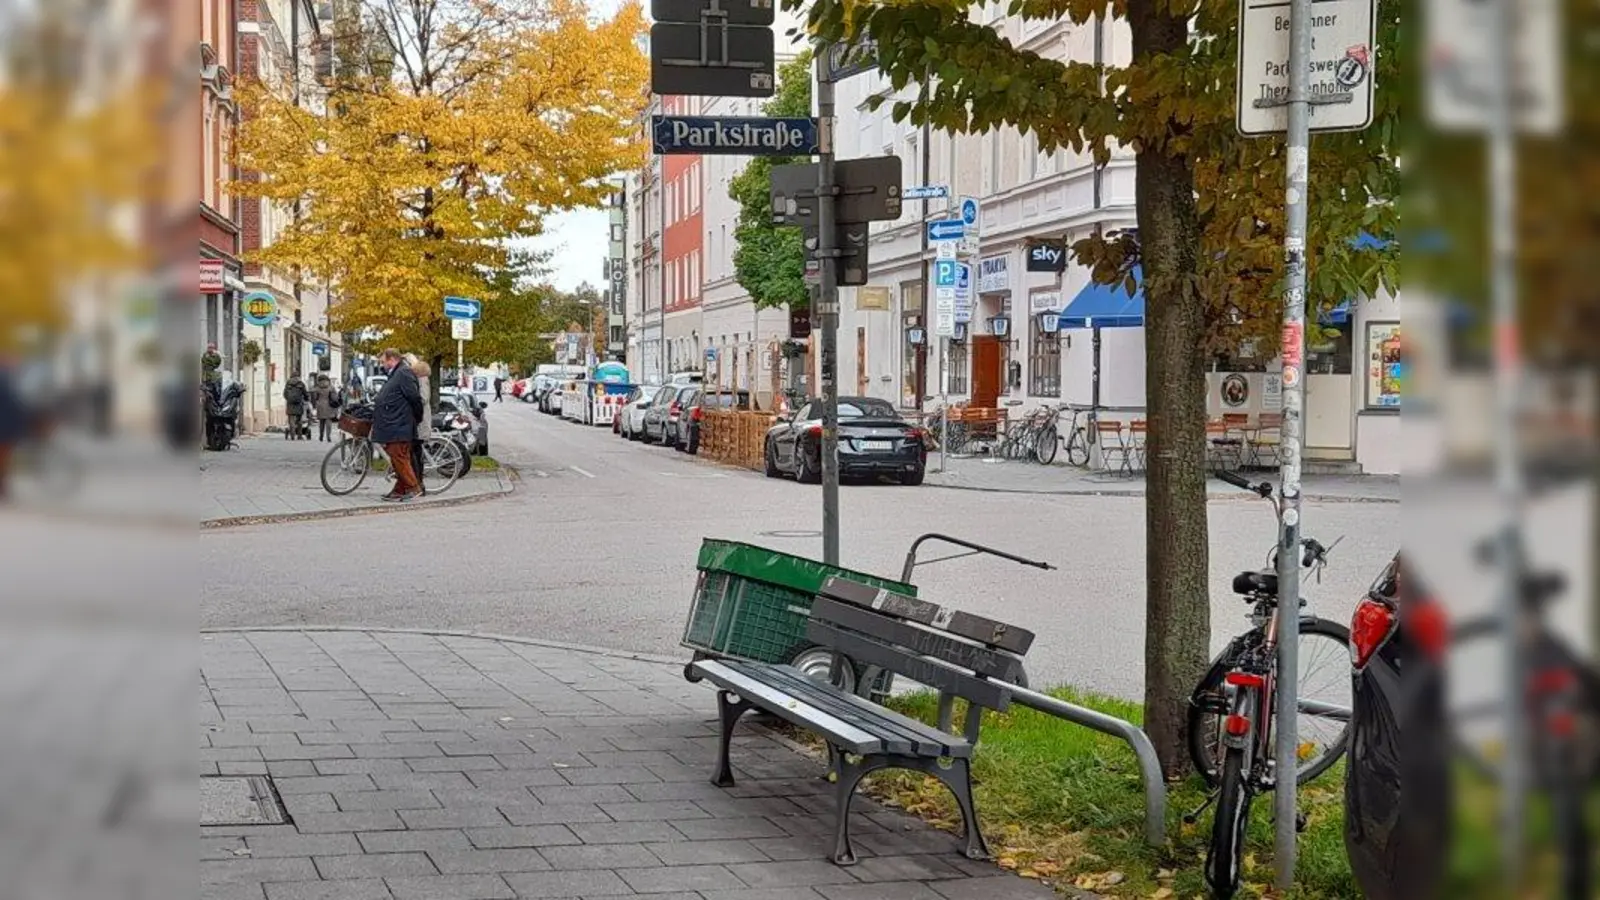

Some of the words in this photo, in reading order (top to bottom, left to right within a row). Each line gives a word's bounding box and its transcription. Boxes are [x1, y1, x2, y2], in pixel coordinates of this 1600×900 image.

[1274, 14, 1337, 31] Bener
[672, 120, 803, 150] Parkstraße
[1032, 245, 1061, 264] sky
[939, 263, 951, 284] P
[613, 259, 623, 312] HOTEL
